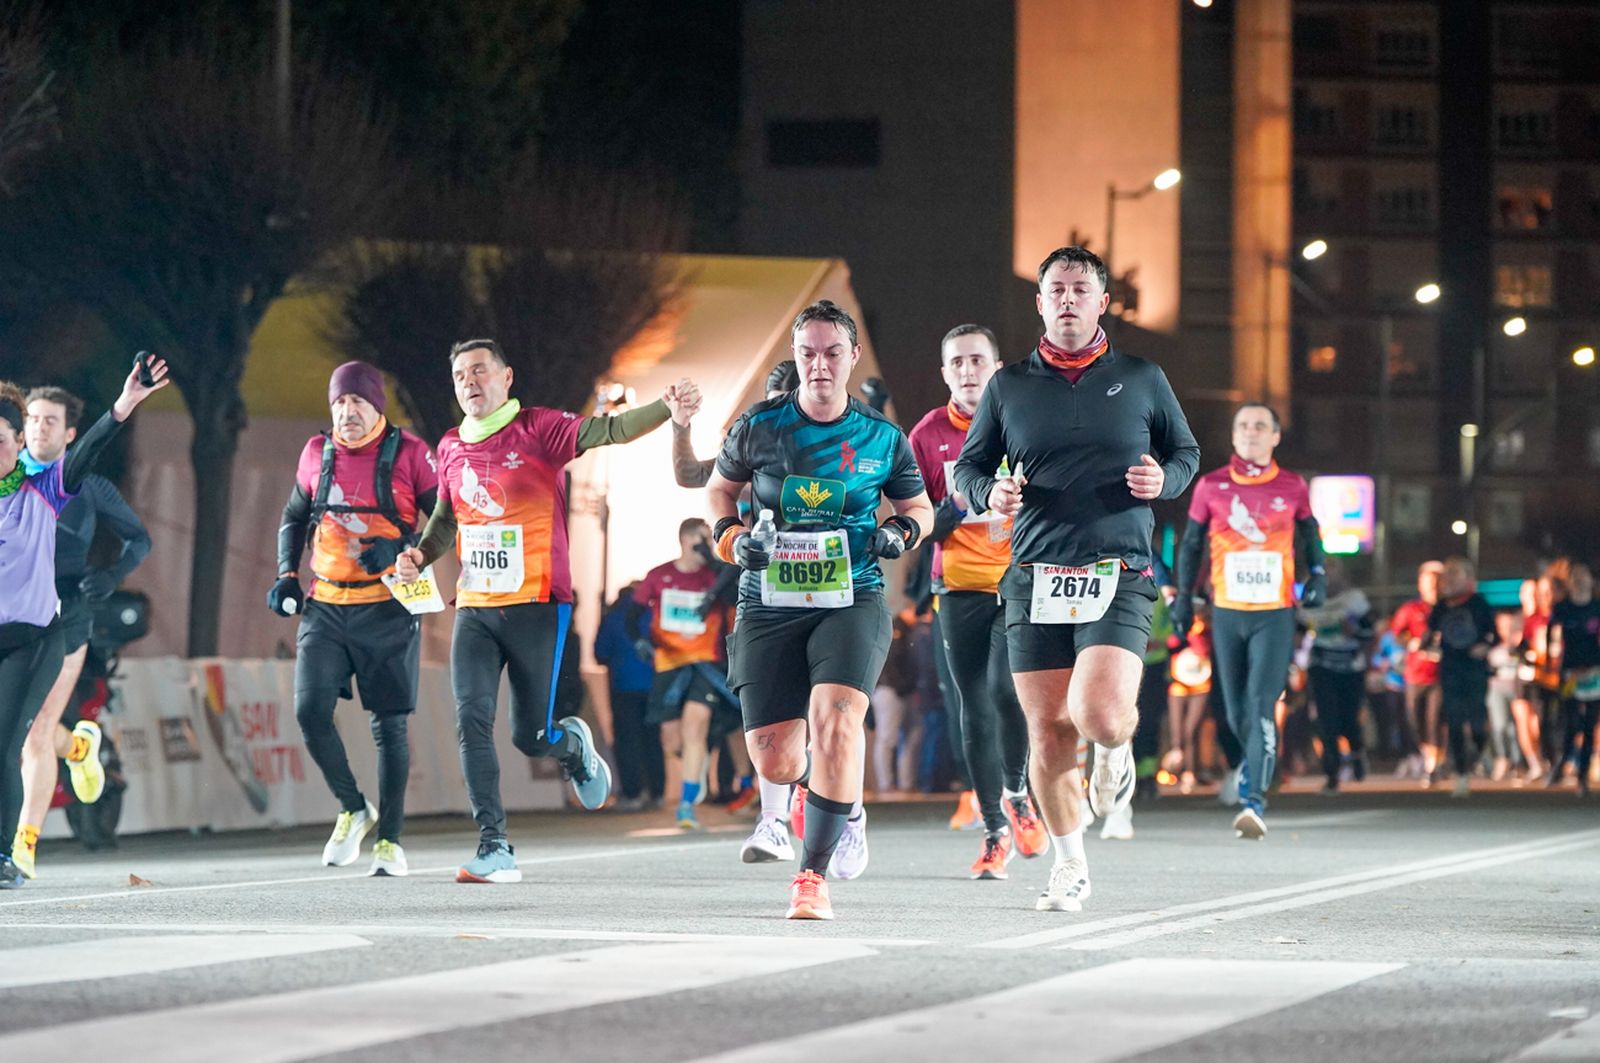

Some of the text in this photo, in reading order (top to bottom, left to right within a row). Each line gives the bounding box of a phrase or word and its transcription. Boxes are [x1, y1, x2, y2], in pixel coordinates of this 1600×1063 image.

[782, 542, 818, 551] NOCHE DE
[470, 550, 508, 569] 4766
[775, 552, 790, 560] SAN
[779, 561, 837, 584] 8692
[1043, 566, 1059, 575] SAN
[1236, 571, 1271, 584] 6504
[1050, 576, 1101, 598] 2674
